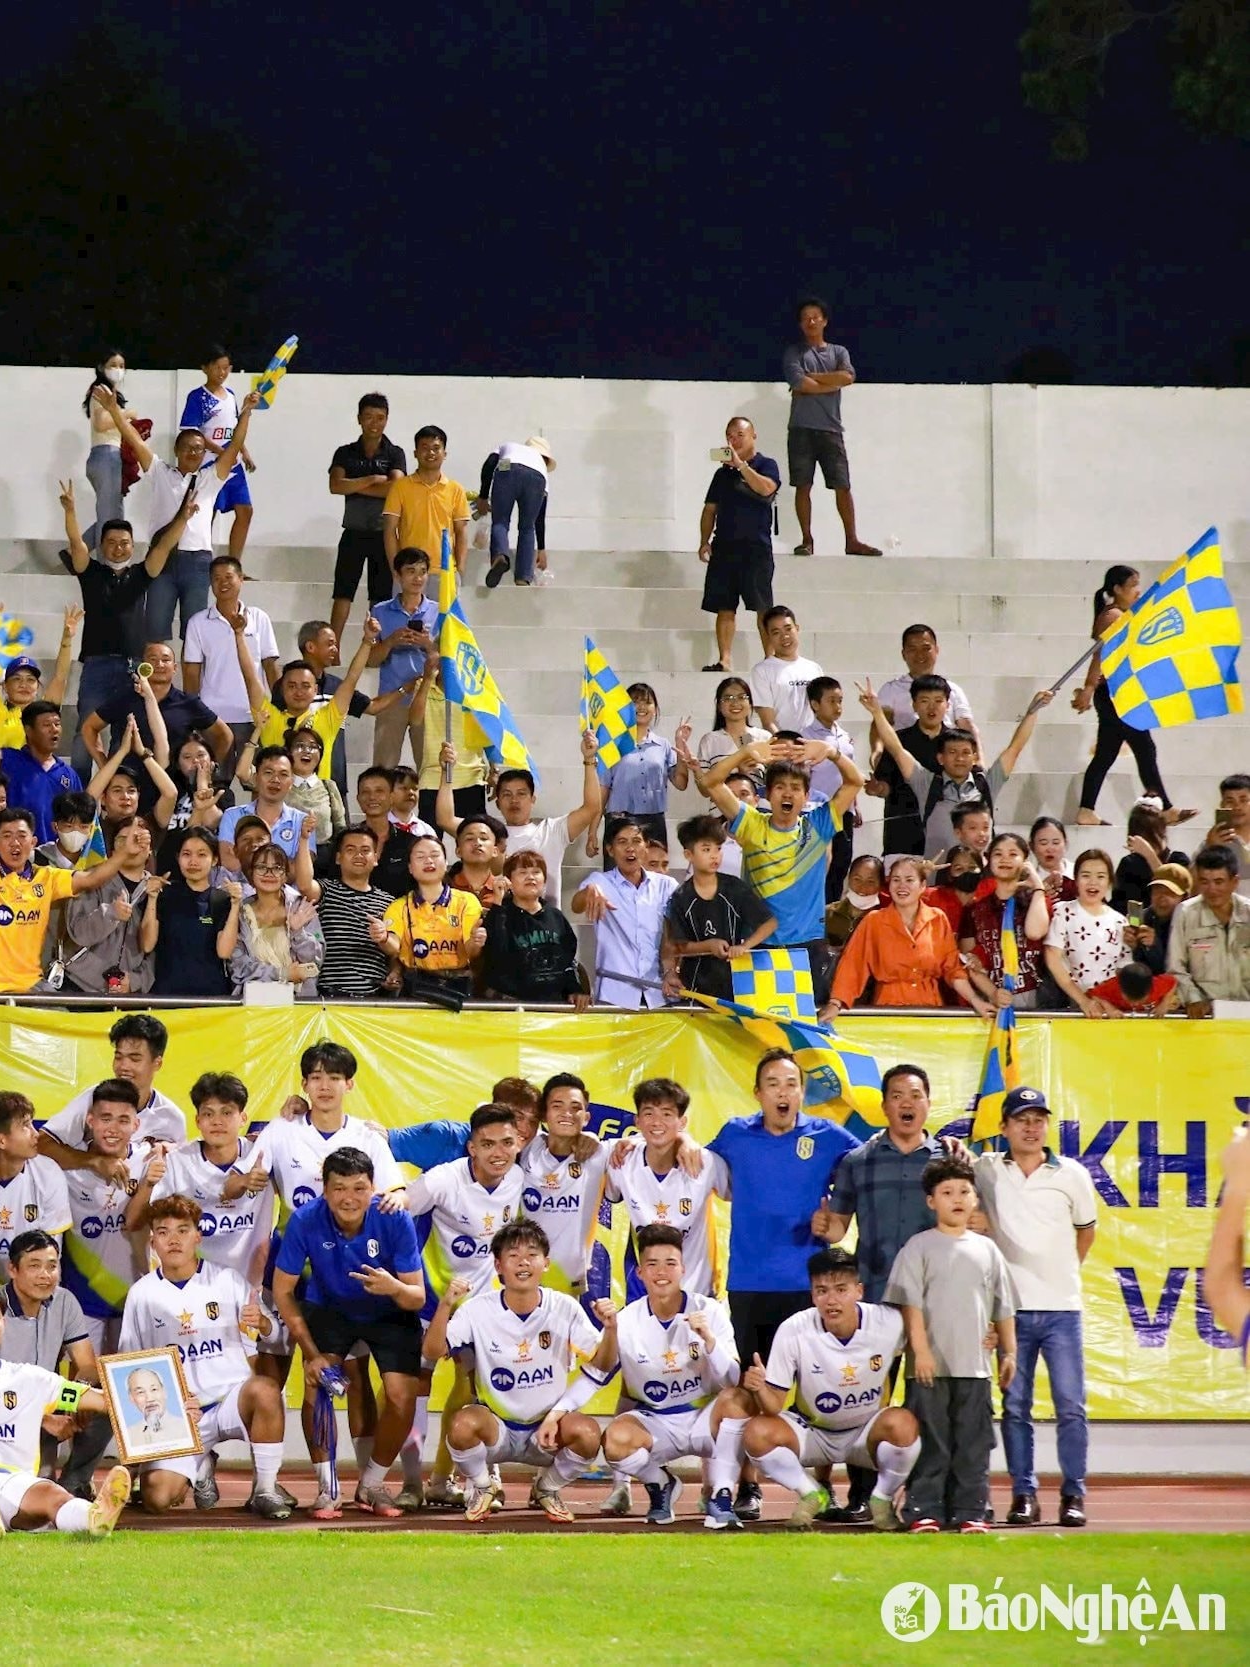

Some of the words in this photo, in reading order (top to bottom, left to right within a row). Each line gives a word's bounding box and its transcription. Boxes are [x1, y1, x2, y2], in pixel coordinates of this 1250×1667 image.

[429, 940, 459, 951] AAN
[542, 1195, 580, 1208] AAN
[219, 1212, 254, 1228] AAN
[188, 1339, 222, 1357] AAN
[517, 1365, 553, 1384] AAN
[844, 1386, 882, 1405] AAN
